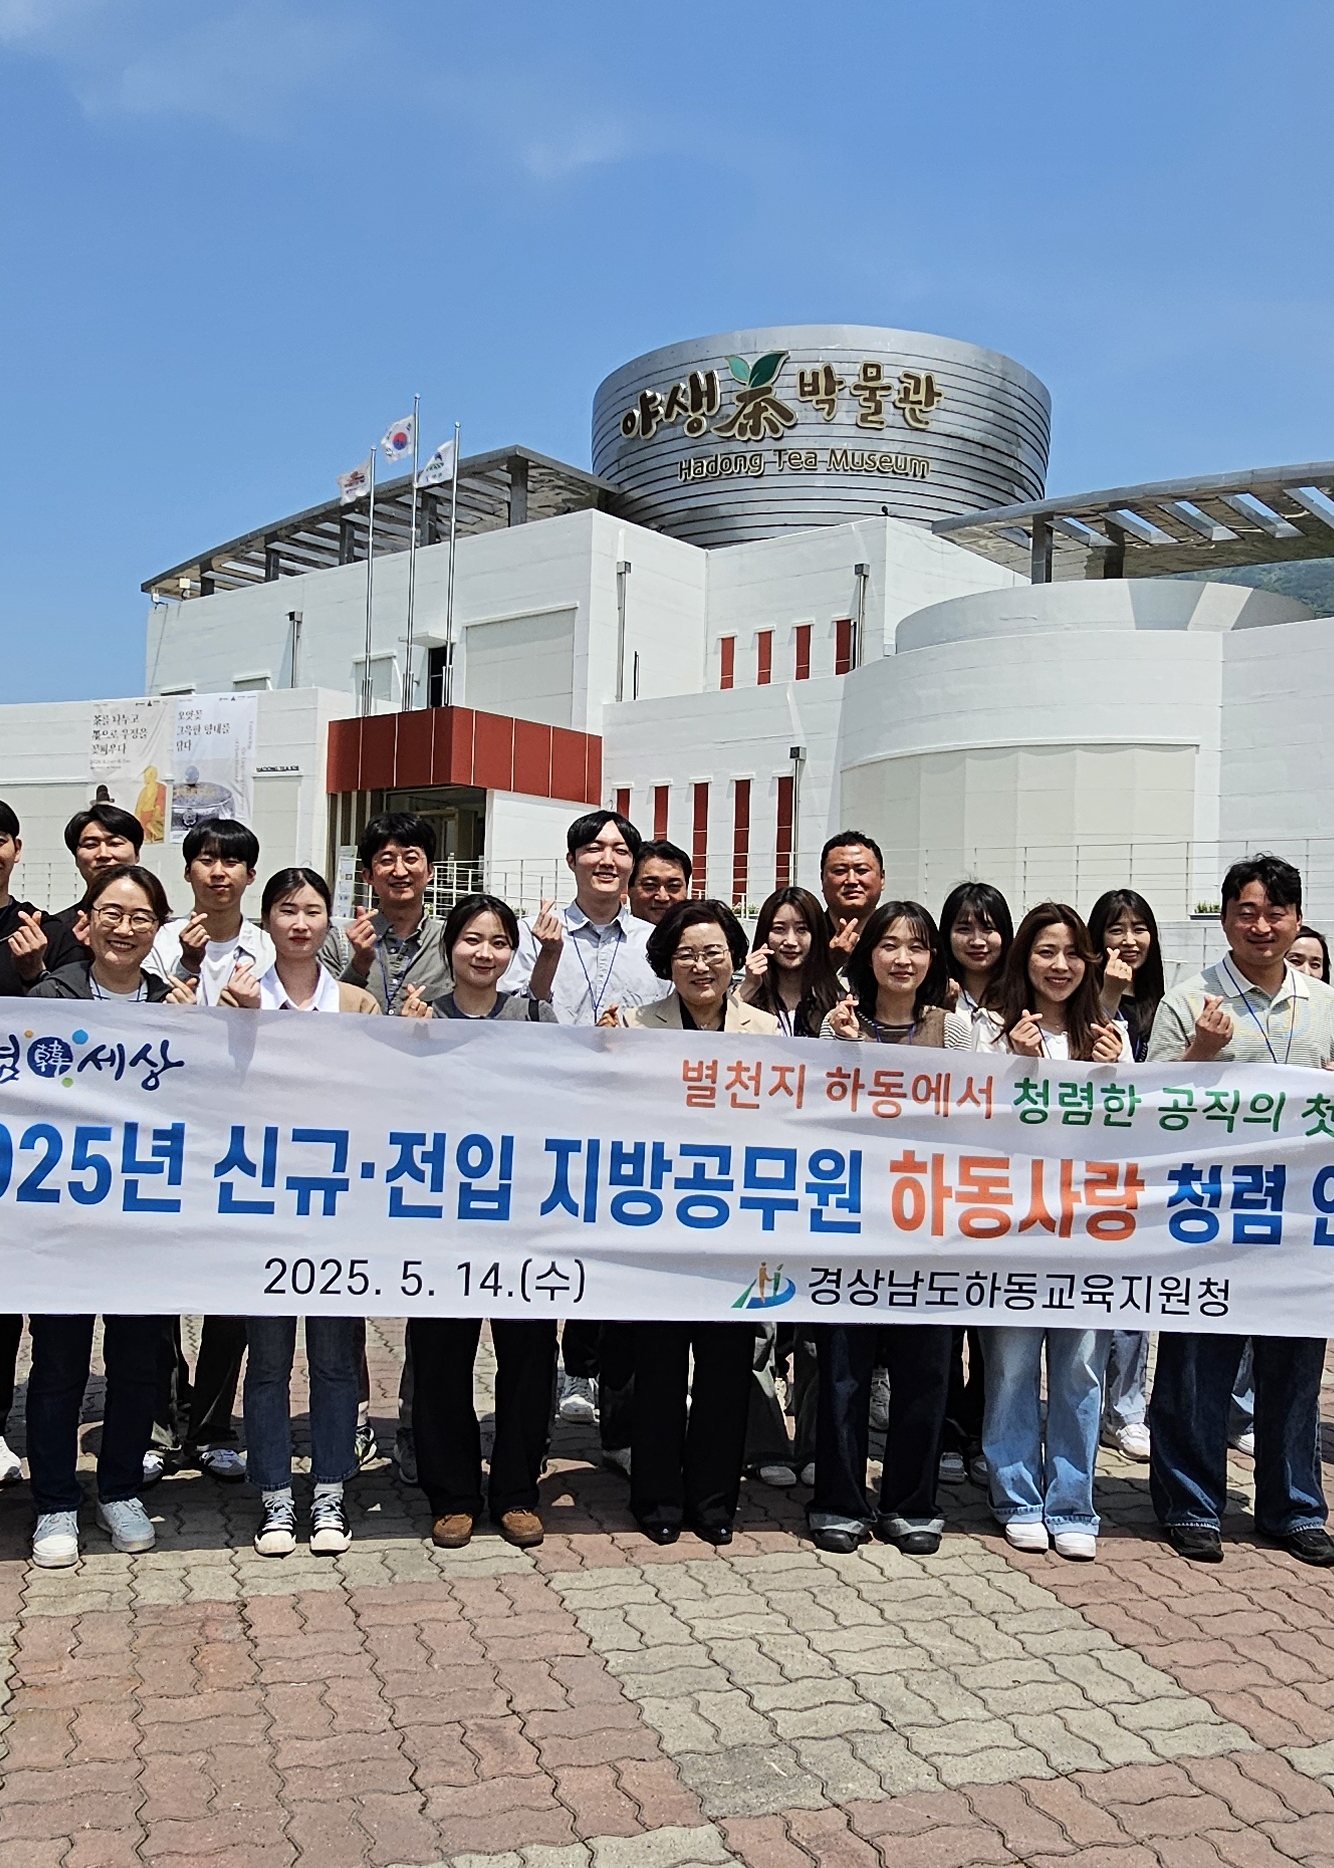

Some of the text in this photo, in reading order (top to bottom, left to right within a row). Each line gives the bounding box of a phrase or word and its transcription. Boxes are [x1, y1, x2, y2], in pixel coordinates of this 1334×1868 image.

[677, 448, 931, 481] Hadong Tea Museum
[682, 1059, 805, 1109] 별천지
[826, 1066, 993, 1120] 하동에서
[1014, 1077, 1142, 1128] 청렴한
[1158, 1086, 1287, 1134] 공직의
[214, 1125, 515, 1221] 신규·전입
[540, 1138, 863, 1234] 지방공무원
[889, 1150, 1145, 1241] 하동사랑
[1166, 1162, 1287, 1246] 청렴
[264, 1257, 585, 1303] 2025. 5. 14.(수)
[807, 1267, 1231, 1318] 경상남도하동교육지원청
